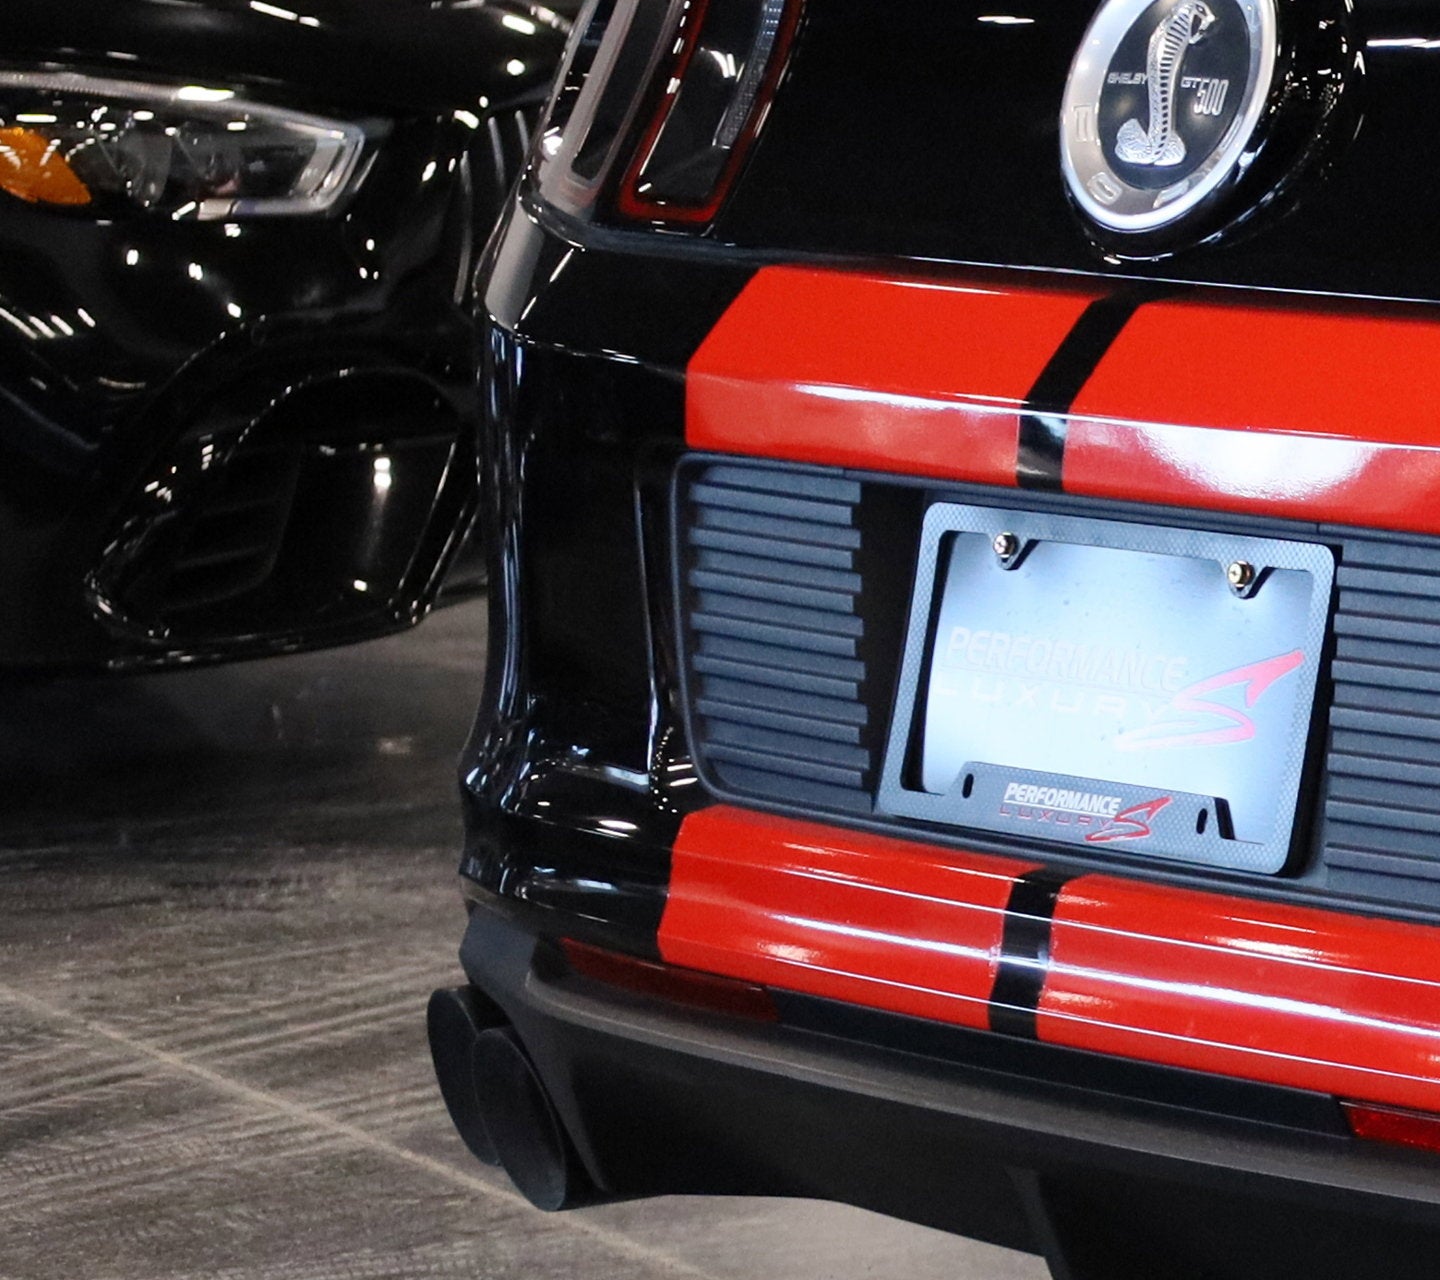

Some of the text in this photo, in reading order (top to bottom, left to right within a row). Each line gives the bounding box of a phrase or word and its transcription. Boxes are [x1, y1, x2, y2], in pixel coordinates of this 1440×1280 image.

[1106, 71, 1148, 85] SHELBY
[943, 626, 1189, 693] PERFORMANCE
[933, 673, 1172, 720] LUXURY
[1003, 782, 1122, 815] PERFORMANCE
[999, 805, 1113, 830] LUXURY
